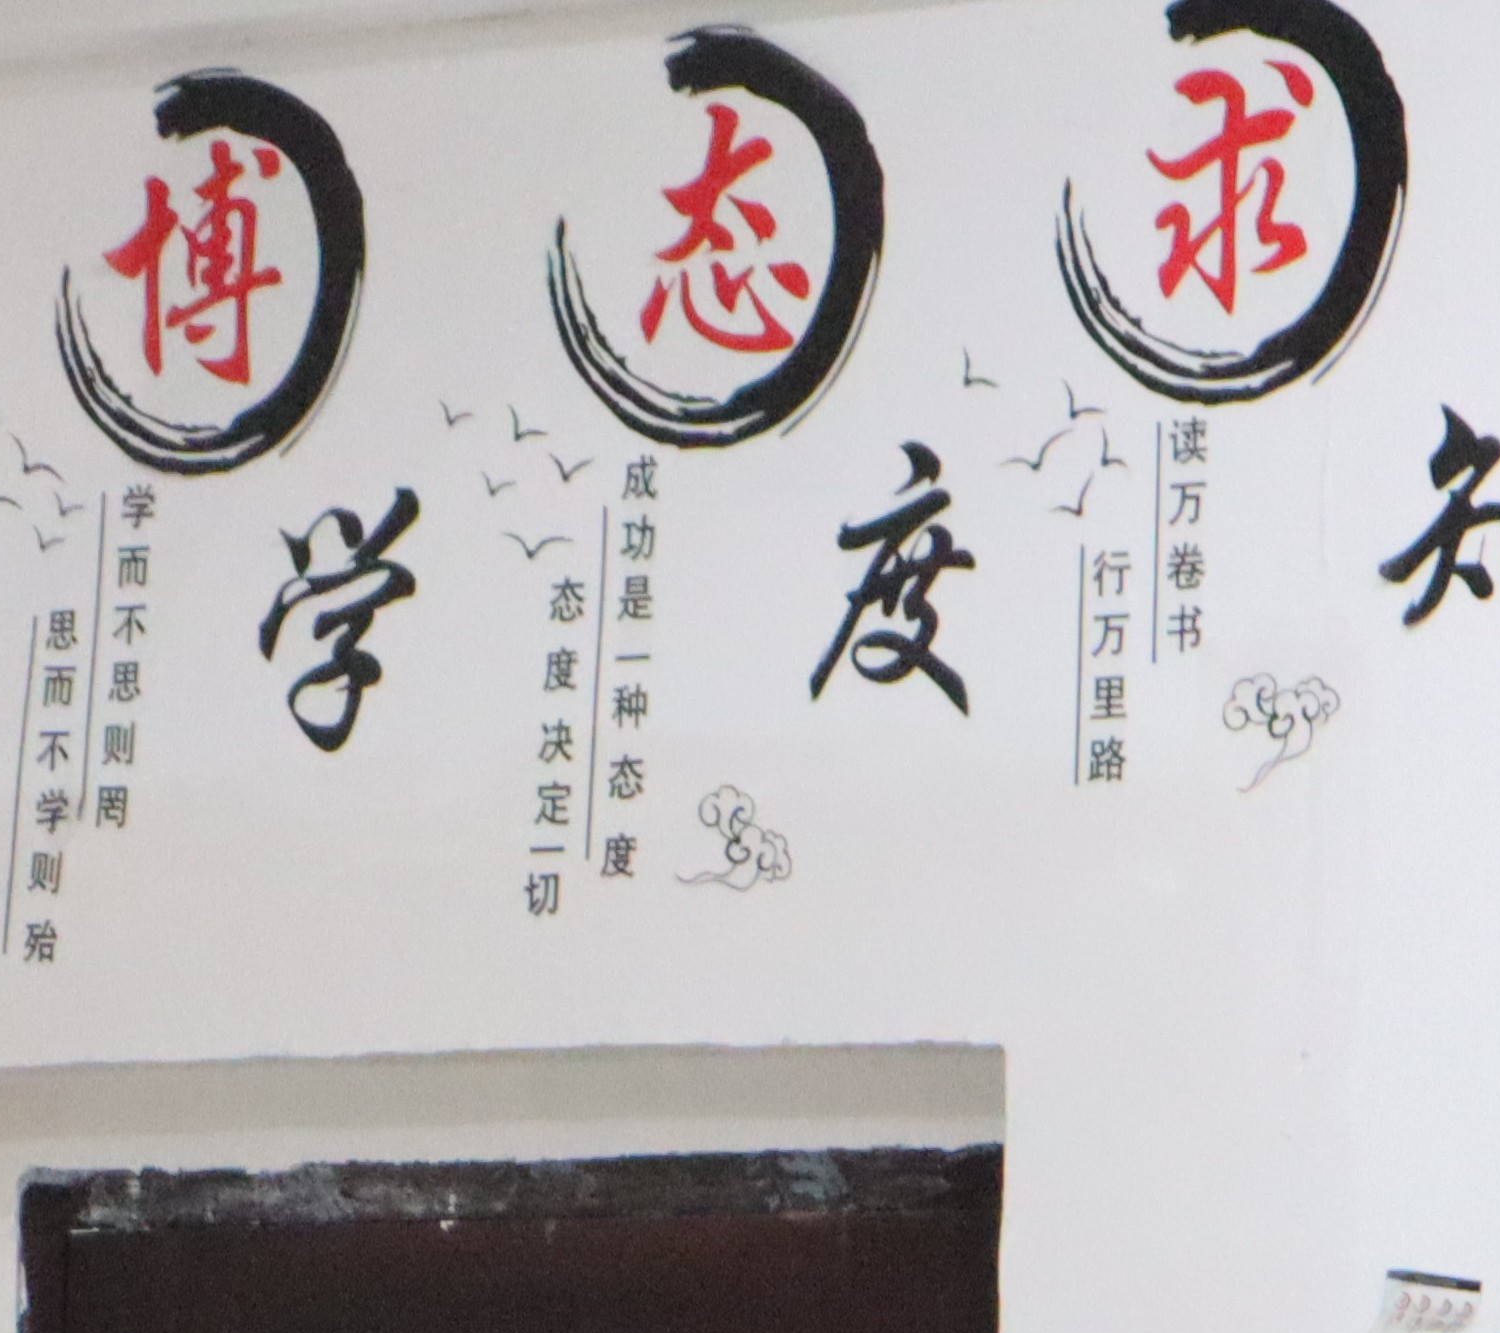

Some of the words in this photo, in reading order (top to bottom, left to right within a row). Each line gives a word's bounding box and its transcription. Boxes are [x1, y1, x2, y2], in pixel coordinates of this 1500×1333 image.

[103, 140, 282, 385] 博
[640, 103, 811, 354] 态
[1147, 60, 1314, 316] 求
[93, 484, 157, 829] 学而不思则罔
[259, 487, 420, 753] 学
[600, 455, 659, 880] 成功是一种态度
[810, 443, 976, 717] 度
[1087, 550, 1132, 784] 行万里路
[1166, 418, 1208, 653] 读万卷书
[22, 609, 79, 963] 思而不学则殆
[524, 578, 585, 915] 态度决定一切
